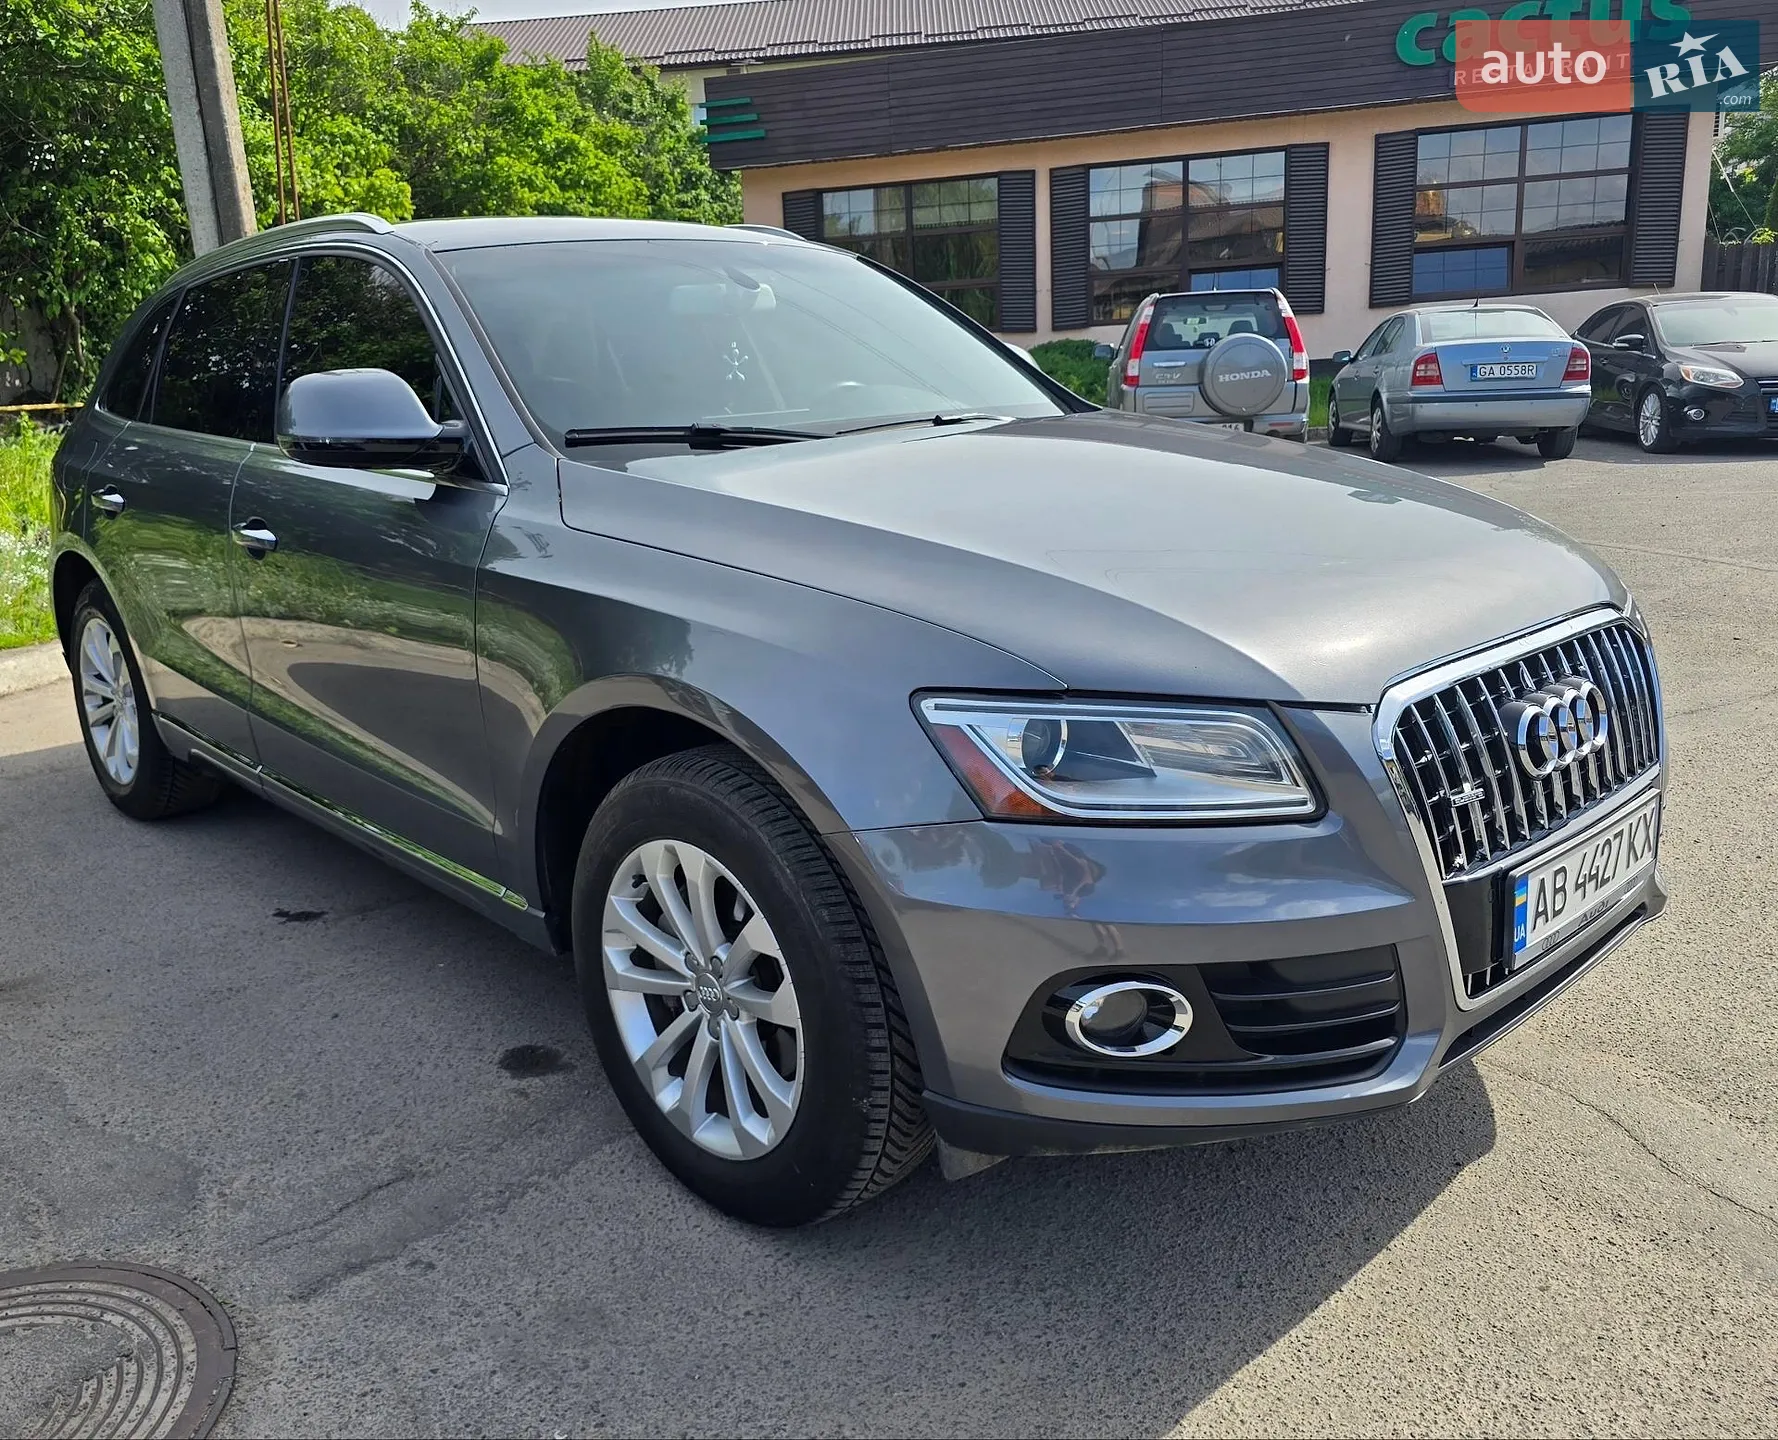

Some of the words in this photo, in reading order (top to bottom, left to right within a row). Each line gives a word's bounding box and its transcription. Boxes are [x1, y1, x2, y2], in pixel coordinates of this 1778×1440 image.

[1218, 369, 1271, 383] HONDA
[1479, 366, 1495, 377] GA
[1499, 364, 1535, 377] 0558R
[1532, 865, 1568, 933] AB
[1573, 828, 1624, 901] 4427
[1626, 804, 1655, 870] KX
[1514, 923, 1526, 942] UA
